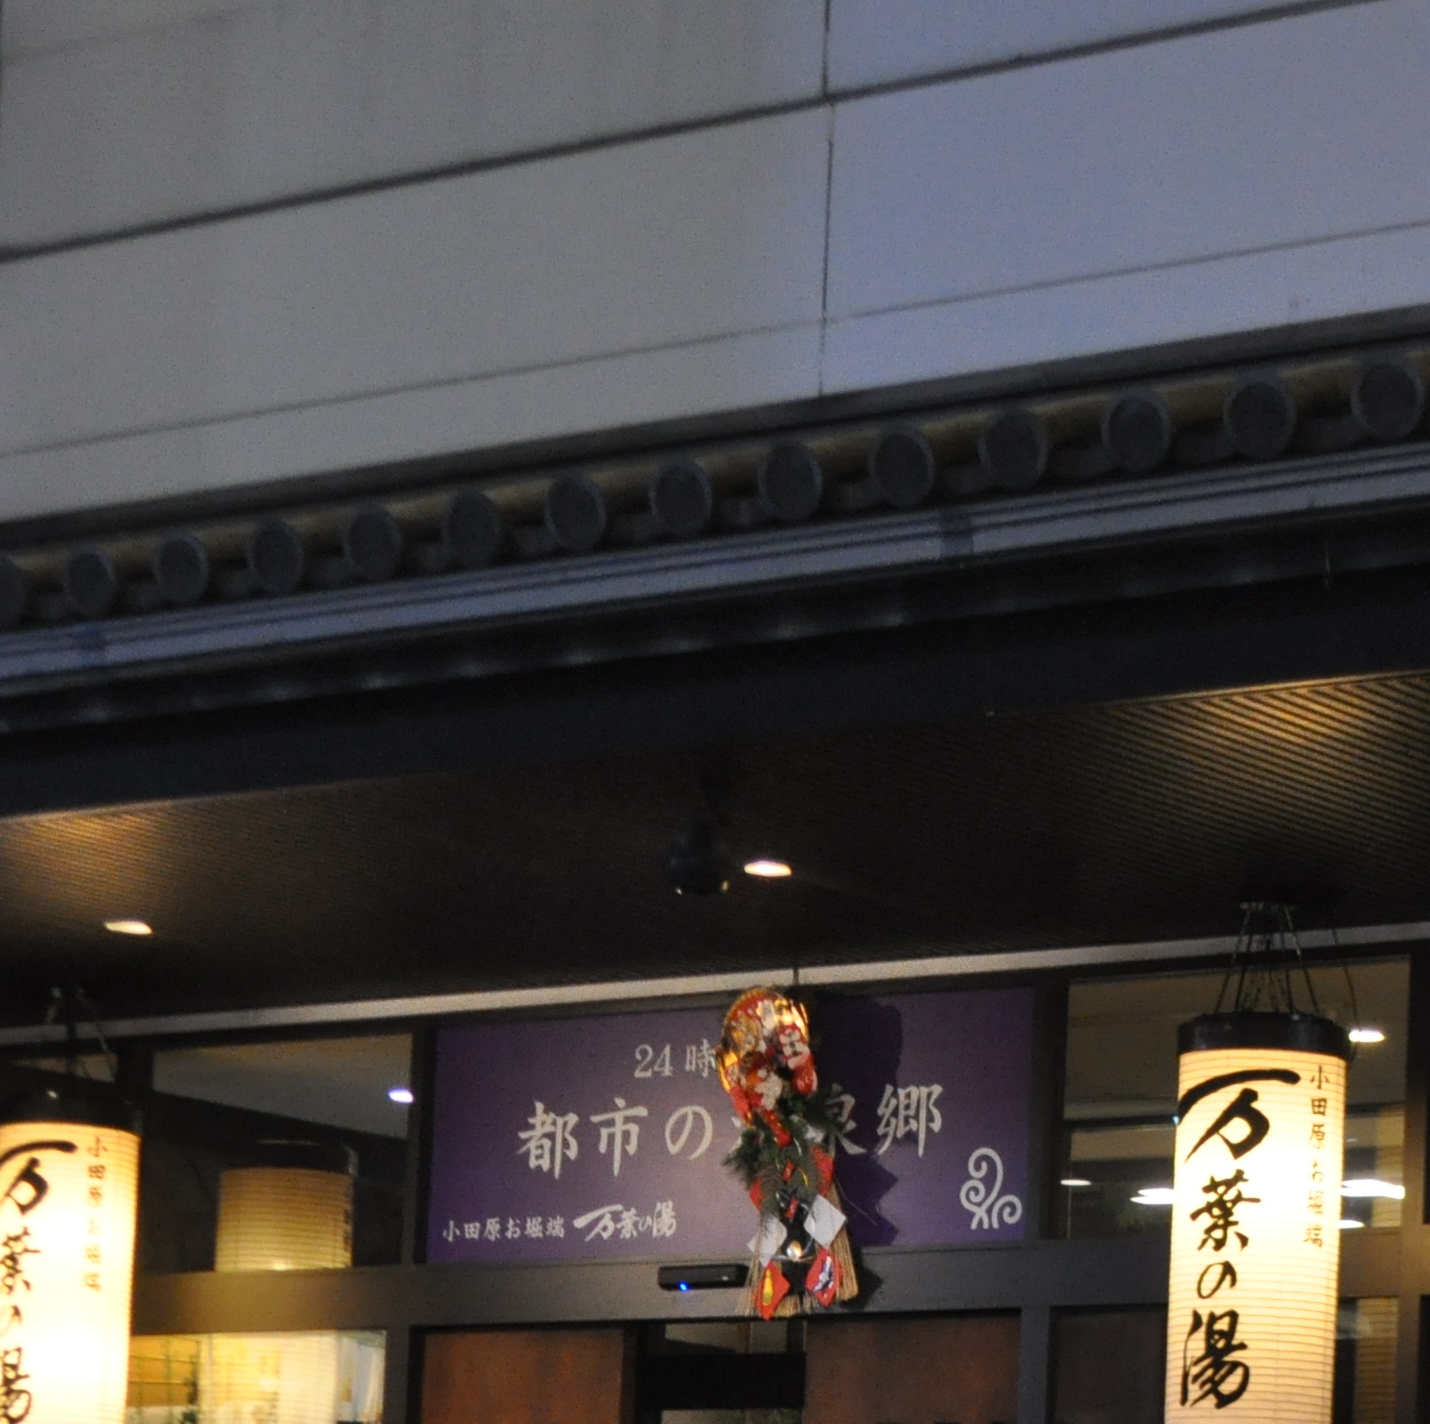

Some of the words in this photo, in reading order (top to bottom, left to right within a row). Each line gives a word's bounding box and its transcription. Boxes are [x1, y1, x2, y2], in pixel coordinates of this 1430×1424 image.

[517, 1083, 943, 1179] 都市の泉郷
[1304, 1065, 1330, 1248] 小田原お堀端
[442, 1214, 566, 1242] 小田原お堀端
[573, 1201, 677, 1242] 万葉の湯
[1176, 1068, 1301, 1409] 万葉の湯
